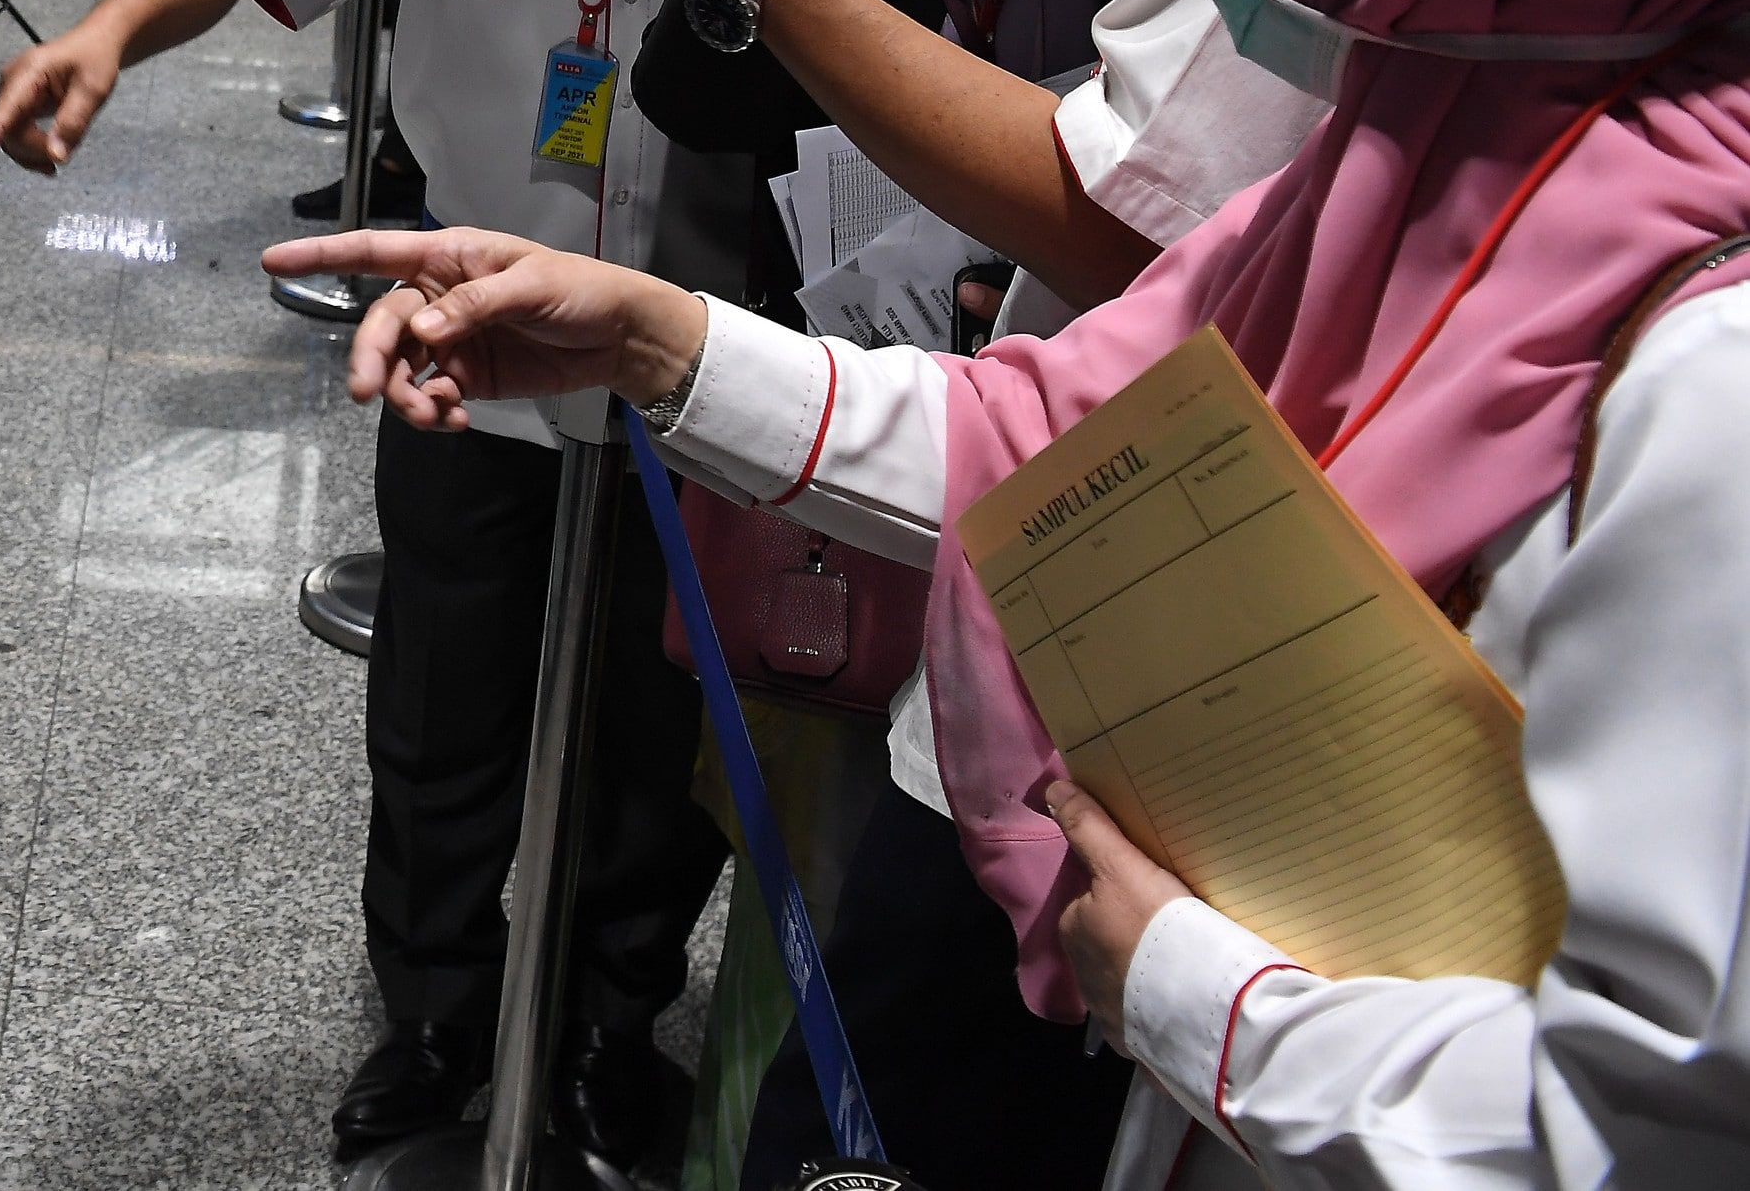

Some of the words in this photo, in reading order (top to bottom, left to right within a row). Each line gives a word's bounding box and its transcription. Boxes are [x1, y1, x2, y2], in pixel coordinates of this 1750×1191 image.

[557, 87, 597, 107] APR
[554, 112, 593, 126] TERMINAL
[1021, 481, 1093, 546] SAMPUL
[1084, 443, 1151, 502] KECIL
